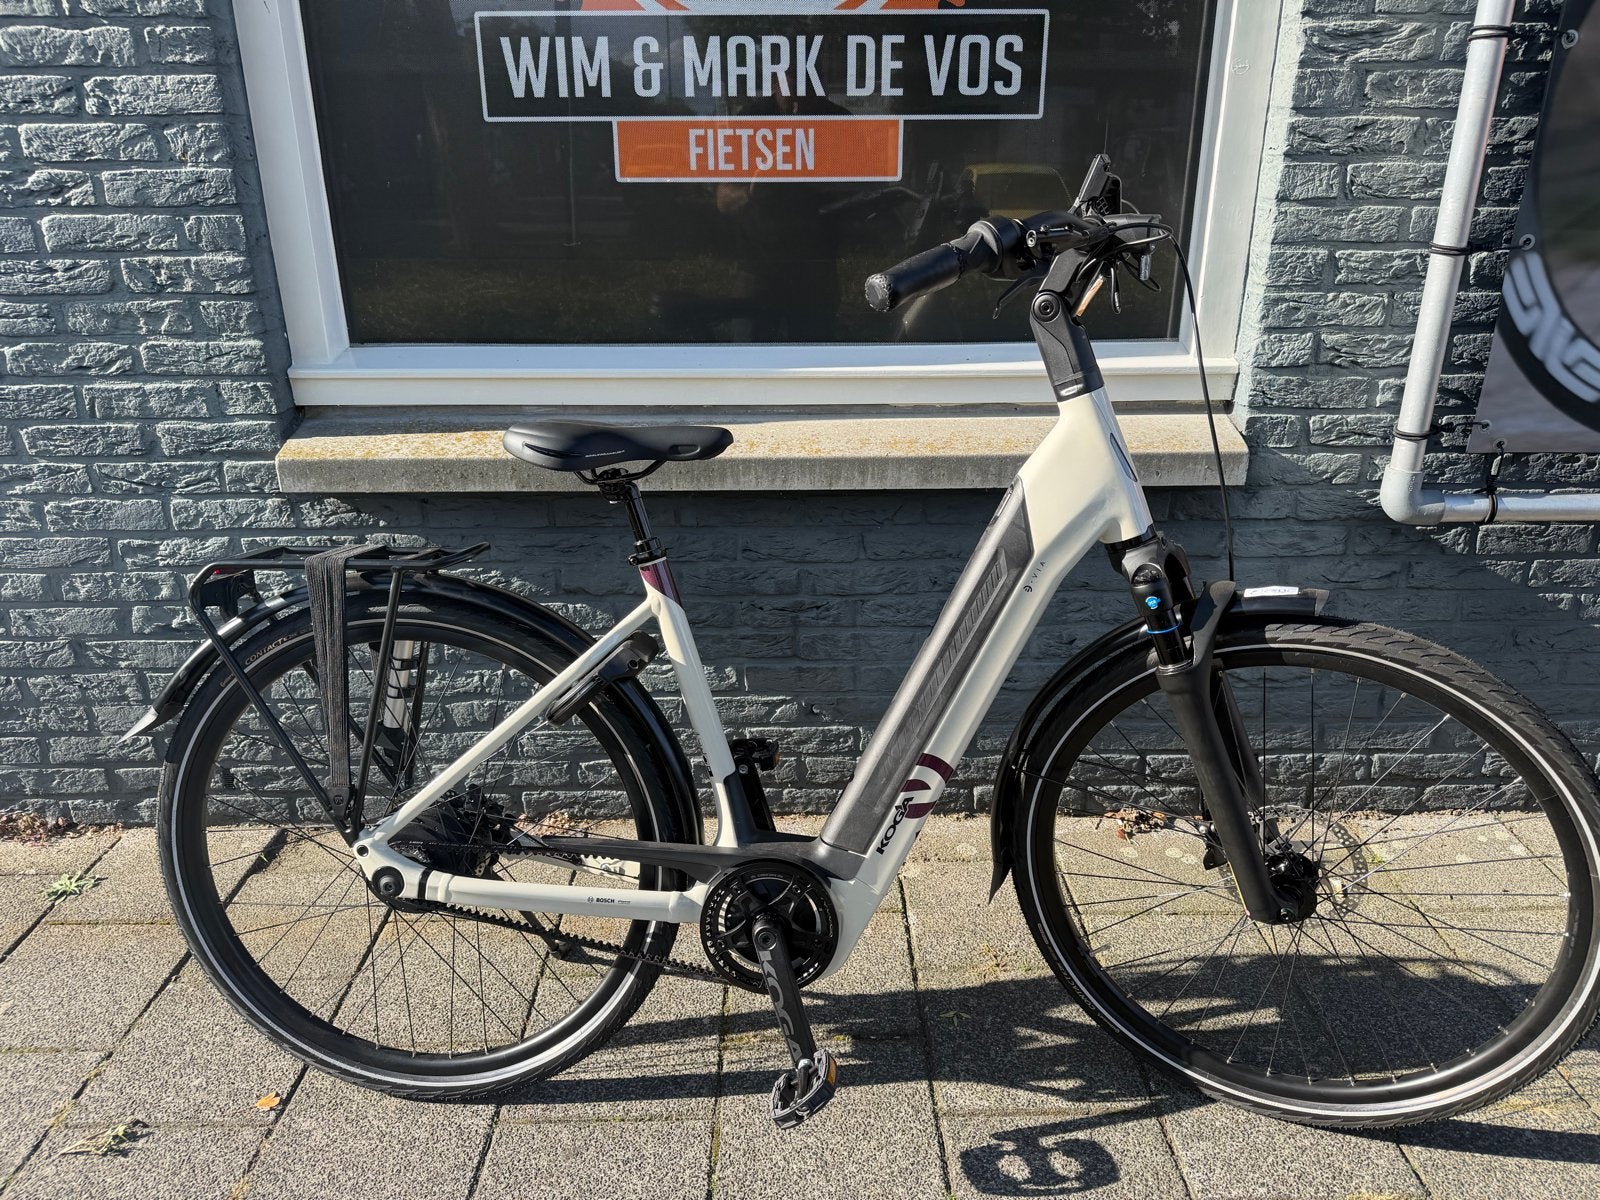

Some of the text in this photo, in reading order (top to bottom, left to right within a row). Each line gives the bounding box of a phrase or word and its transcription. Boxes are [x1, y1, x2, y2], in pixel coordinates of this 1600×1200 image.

[500, 34, 1023, 98] WIM & MARK DE VOS
[688, 128, 815, 171] FIETSEN
[876, 797, 915, 855] KOGA
